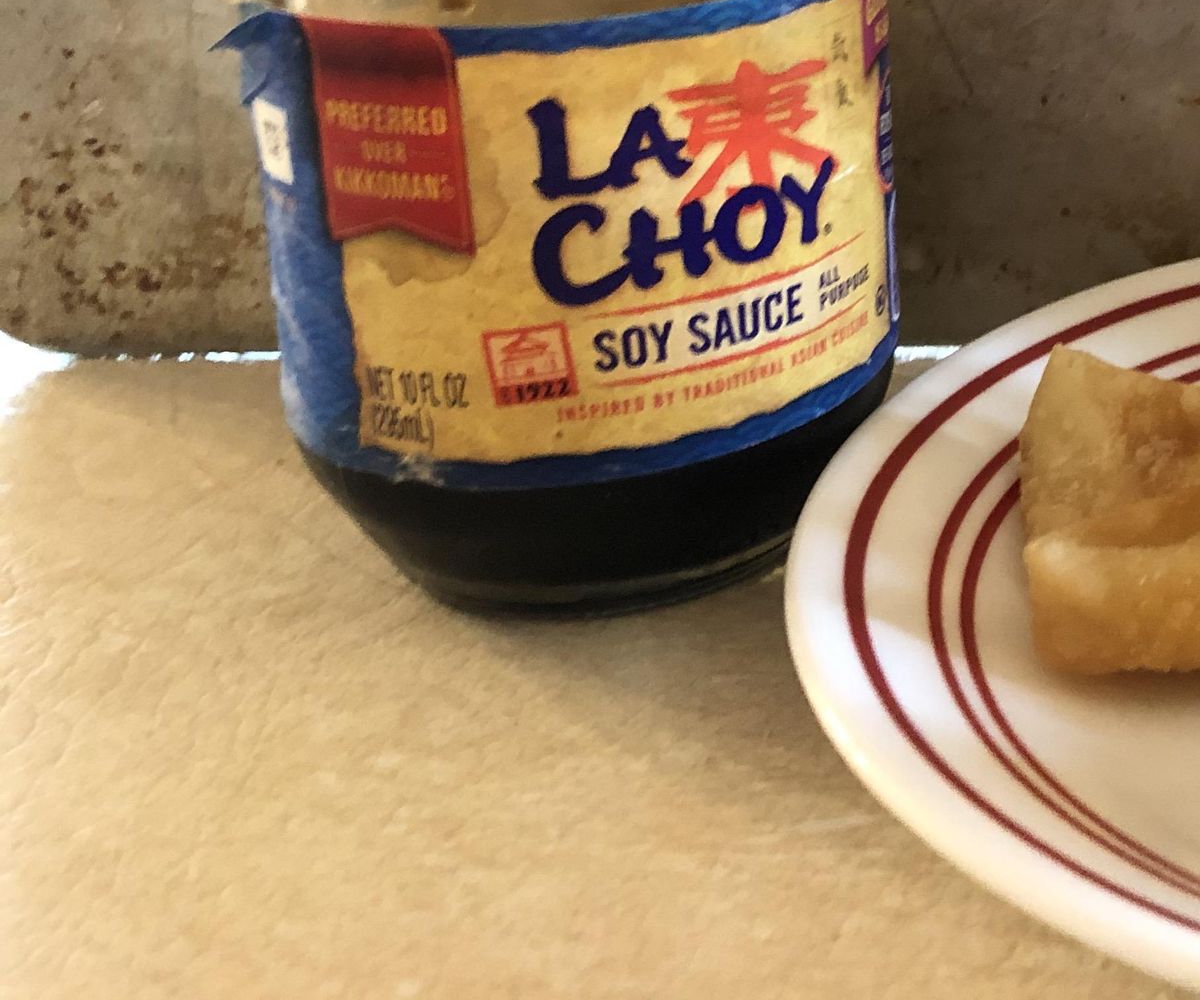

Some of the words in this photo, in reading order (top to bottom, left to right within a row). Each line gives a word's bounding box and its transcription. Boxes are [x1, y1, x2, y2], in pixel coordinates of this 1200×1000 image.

[325, 99, 449, 137] PREFERRED
[361, 138, 408, 165] OVER
[526, 96, 694, 200] LA
[531, 155, 835, 307] CHOY
[819, 264, 840, 292] ALL
[819, 263, 870, 312] PURPOSE
[593, 319, 673, 373] SOY
[687, 281, 804, 356] SAUCE
[366, 366, 394, 401] NET
[442, 371, 471, 409] OZ
[515, 376, 571, 402] 1922
[557, 395, 645, 423] INSPIRED
[652, 391, 676, 409] BY
[683, 358, 784, 402] TRADITIONAL
[790, 337, 828, 367] ASIAN
[831, 309, 870, 346] CUISINE
